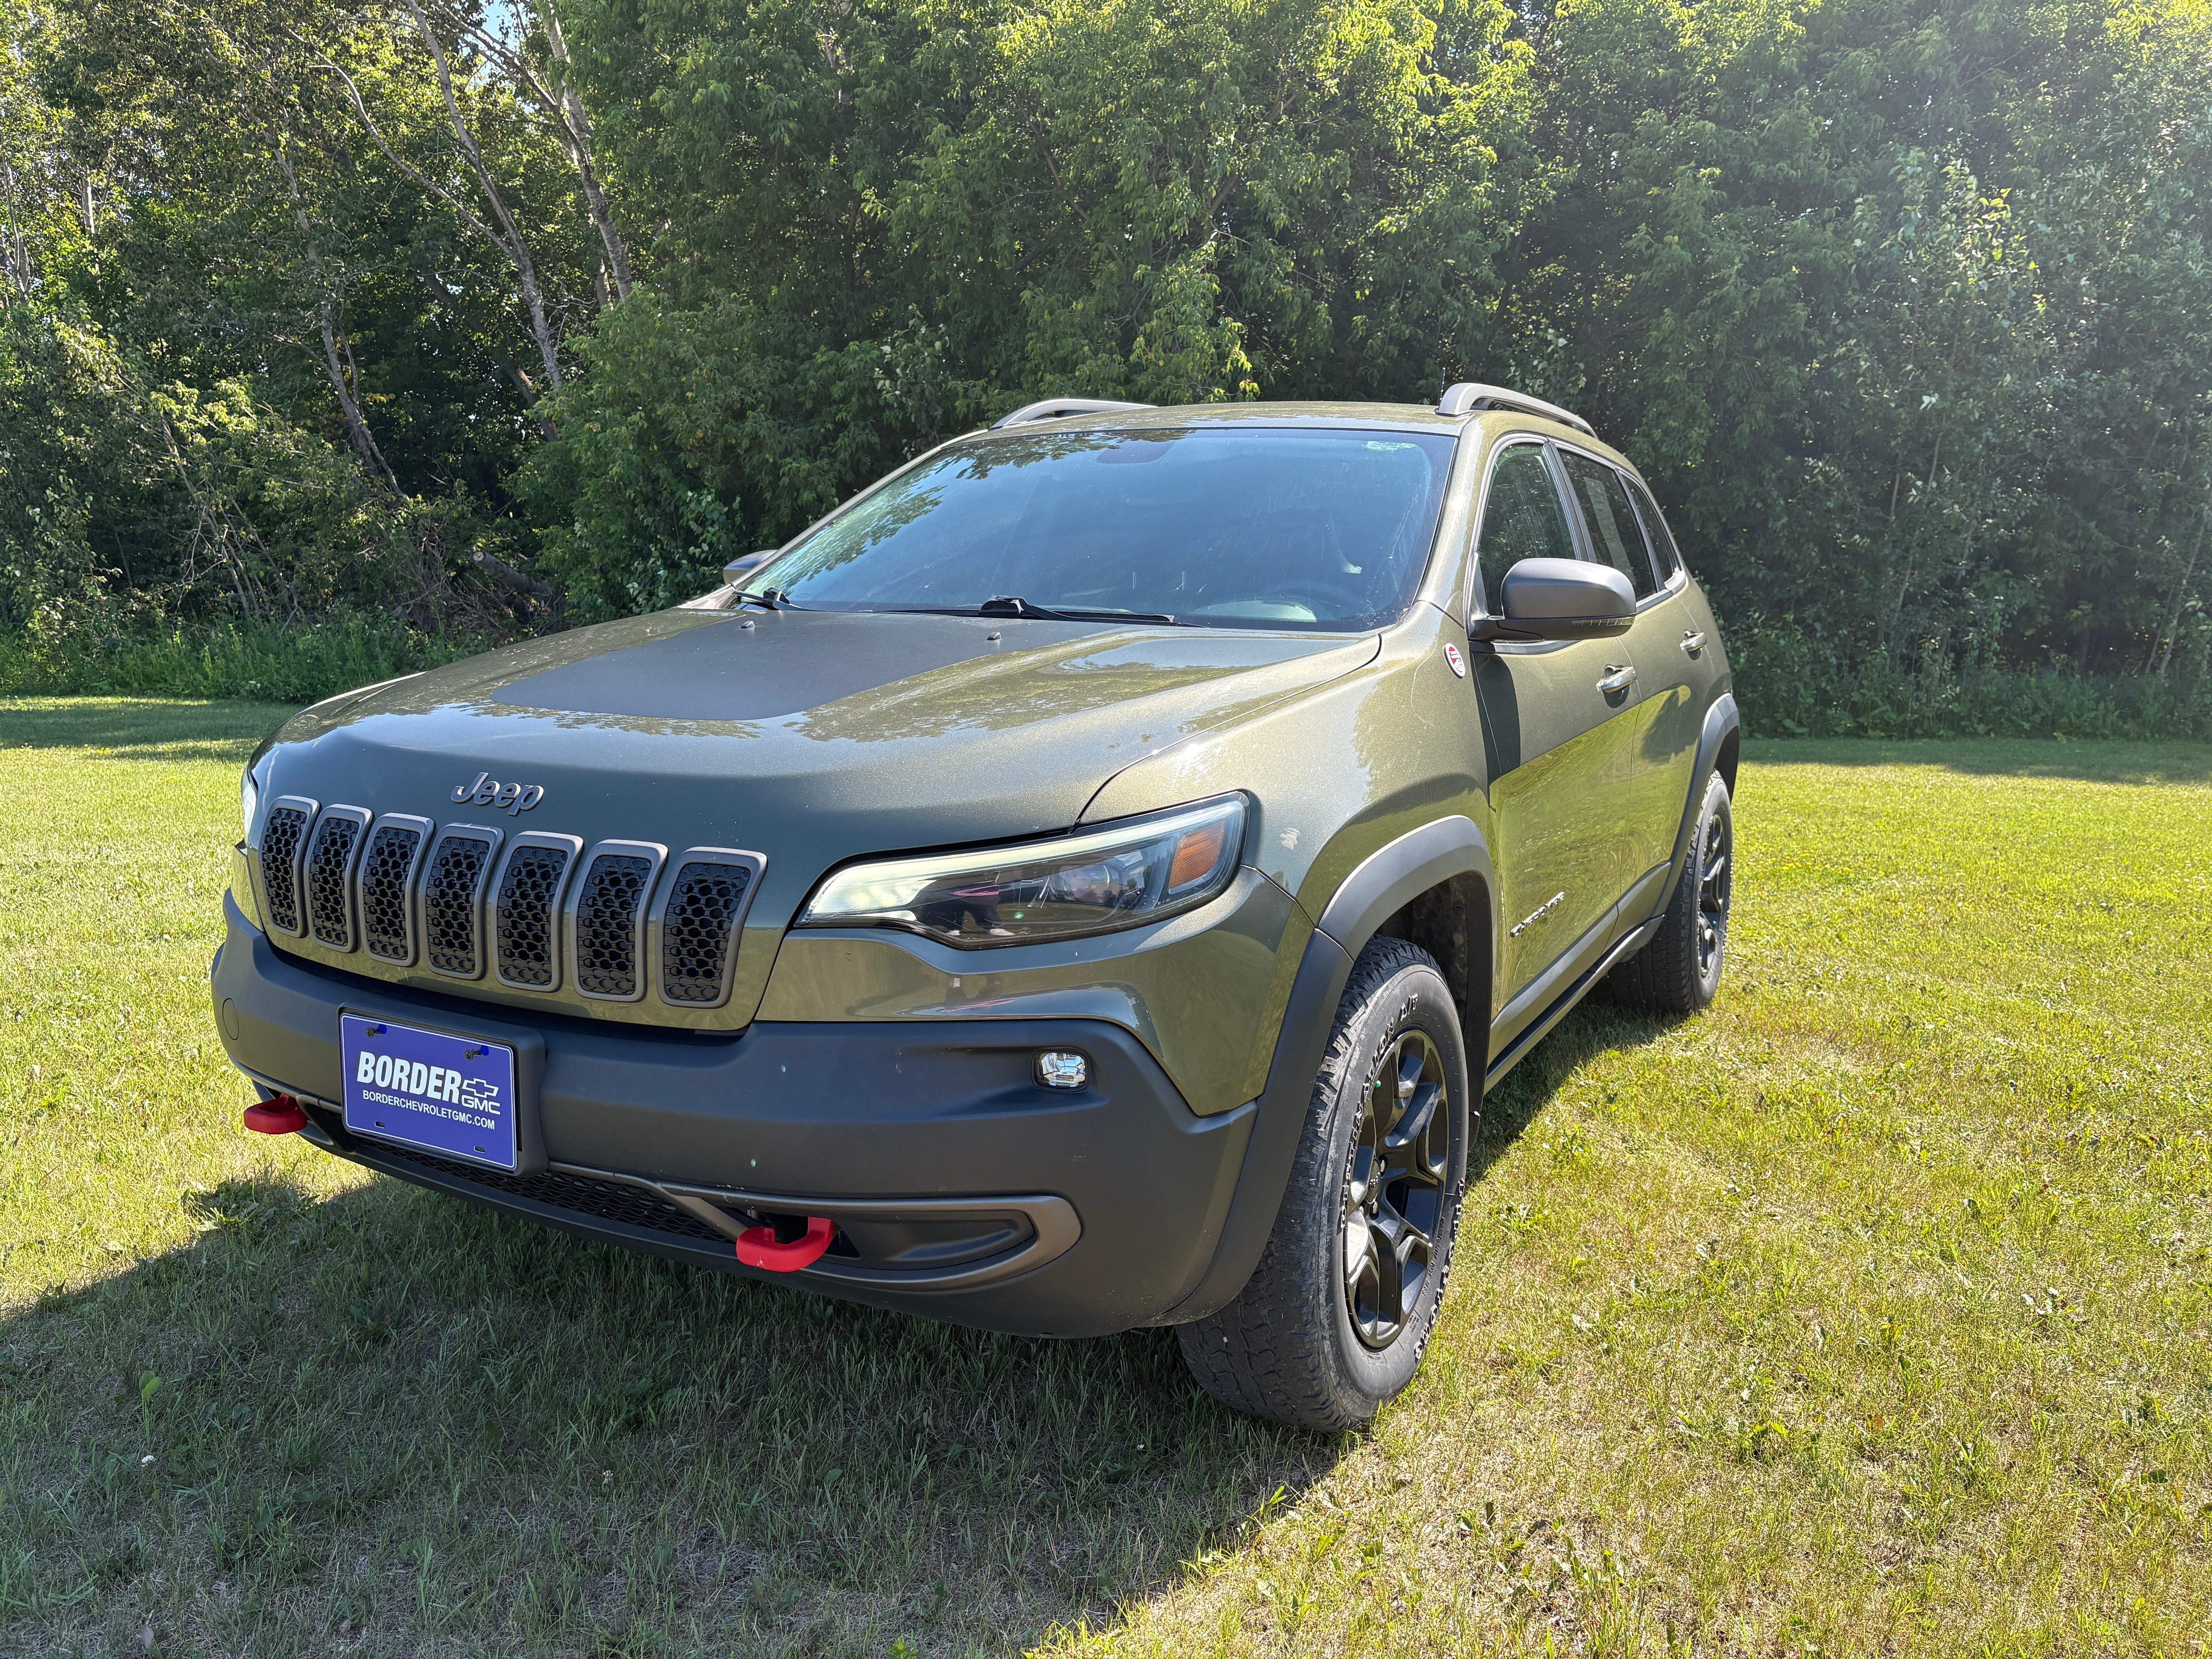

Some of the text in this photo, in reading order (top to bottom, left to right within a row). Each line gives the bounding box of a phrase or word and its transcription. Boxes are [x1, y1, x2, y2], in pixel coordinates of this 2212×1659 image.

[451, 772, 544, 816] Jeep
[1401, 993, 1418, 1022] A/T
[357, 1051, 462, 1104] BORDER
[362, 1090, 495, 1130] BORDERCHEVROLETGMC.COM
[462, 1094, 501, 1115] GMC
